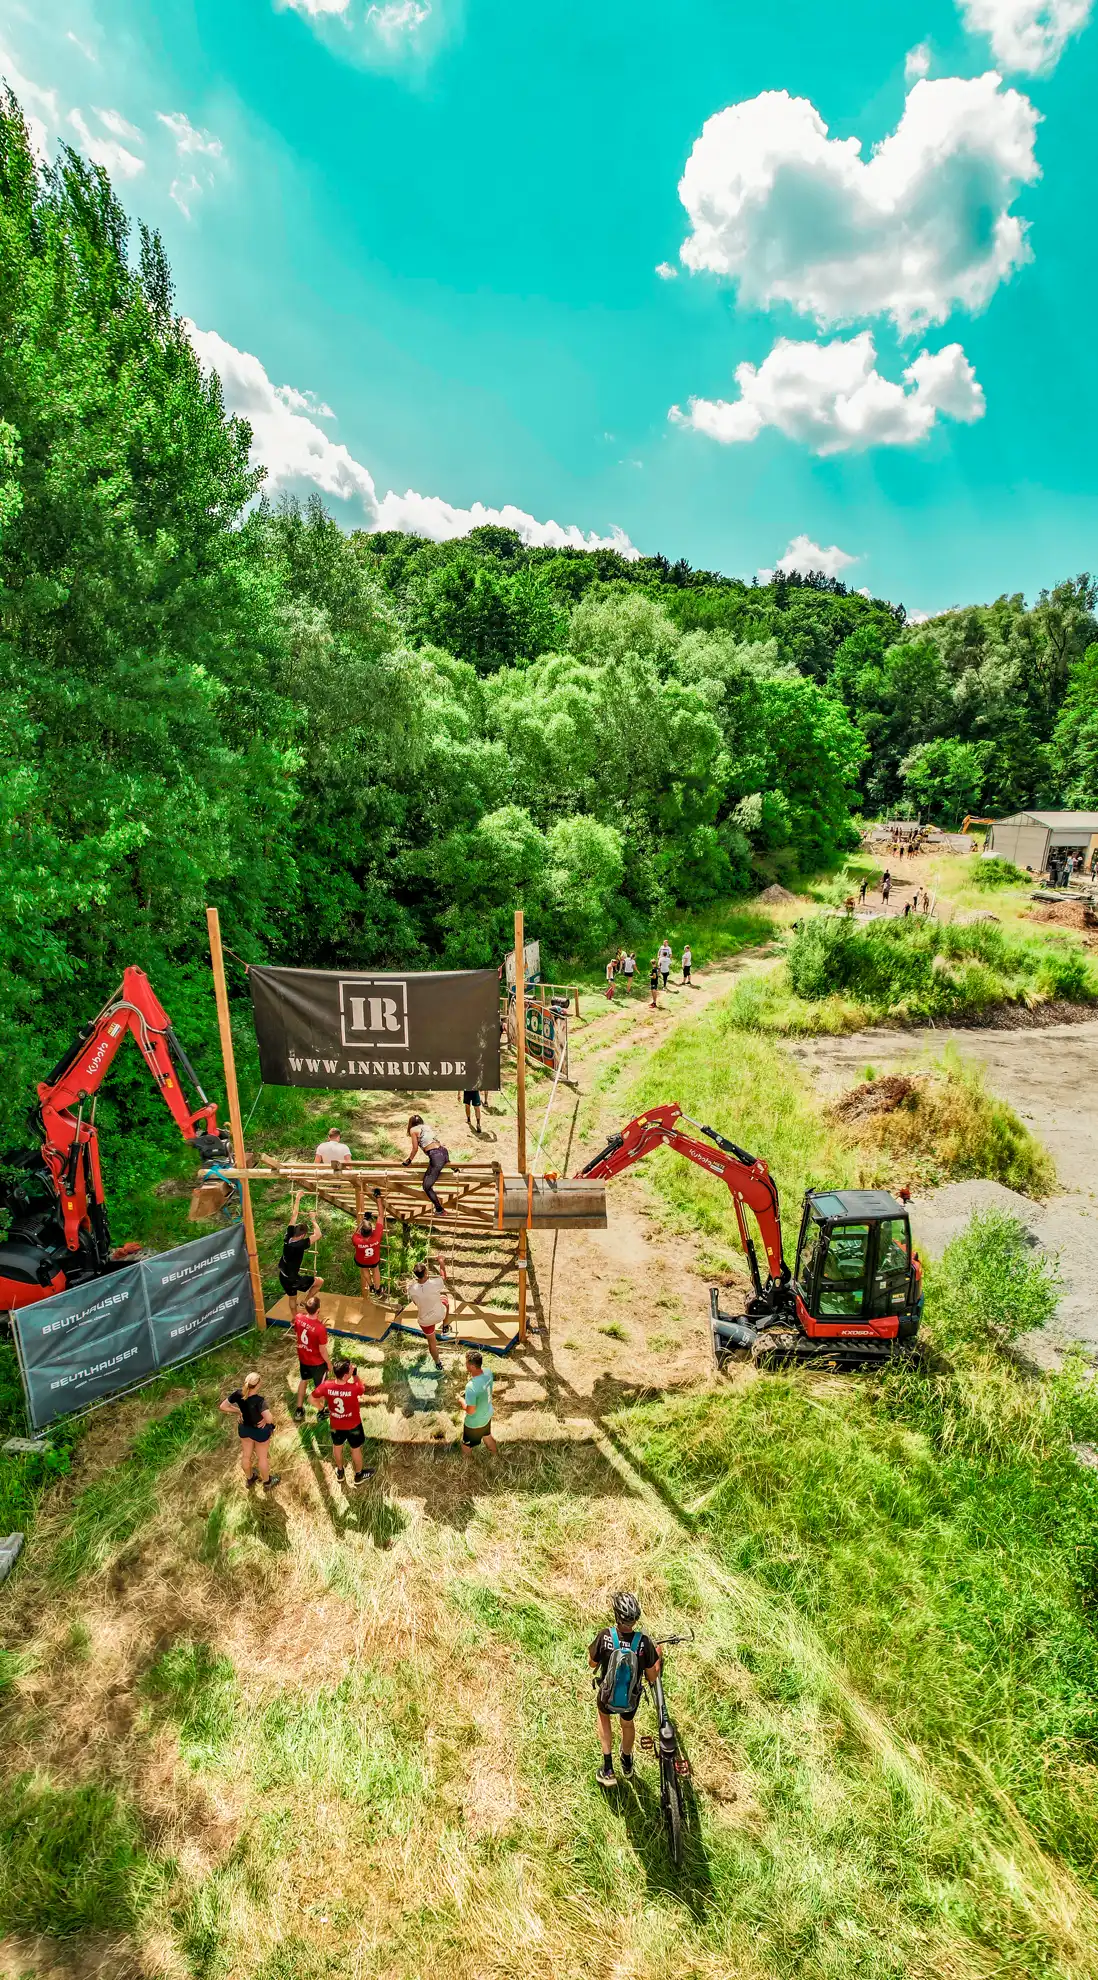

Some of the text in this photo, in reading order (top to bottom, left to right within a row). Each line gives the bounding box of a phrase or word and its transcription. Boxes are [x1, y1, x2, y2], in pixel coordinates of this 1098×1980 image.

[349, 997, 402, 1032] IR
[86, 1042, 109, 1075] Kubota
[288, 1057, 467, 1076] WWW.INNRUN.DE
[689, 1148, 712, 1166] Kubota
[161, 1248, 236, 1285] BEUTLHAUSER
[42, 1291, 130, 1335] BEUTLHAUSER
[170, 1296, 240, 1338] BEUTLHAUSER
[300, 1328, 309, 1346] 6
[50, 1346, 138, 1390] BEUTLHAUSER
[333, 1397, 345, 1414] 3
